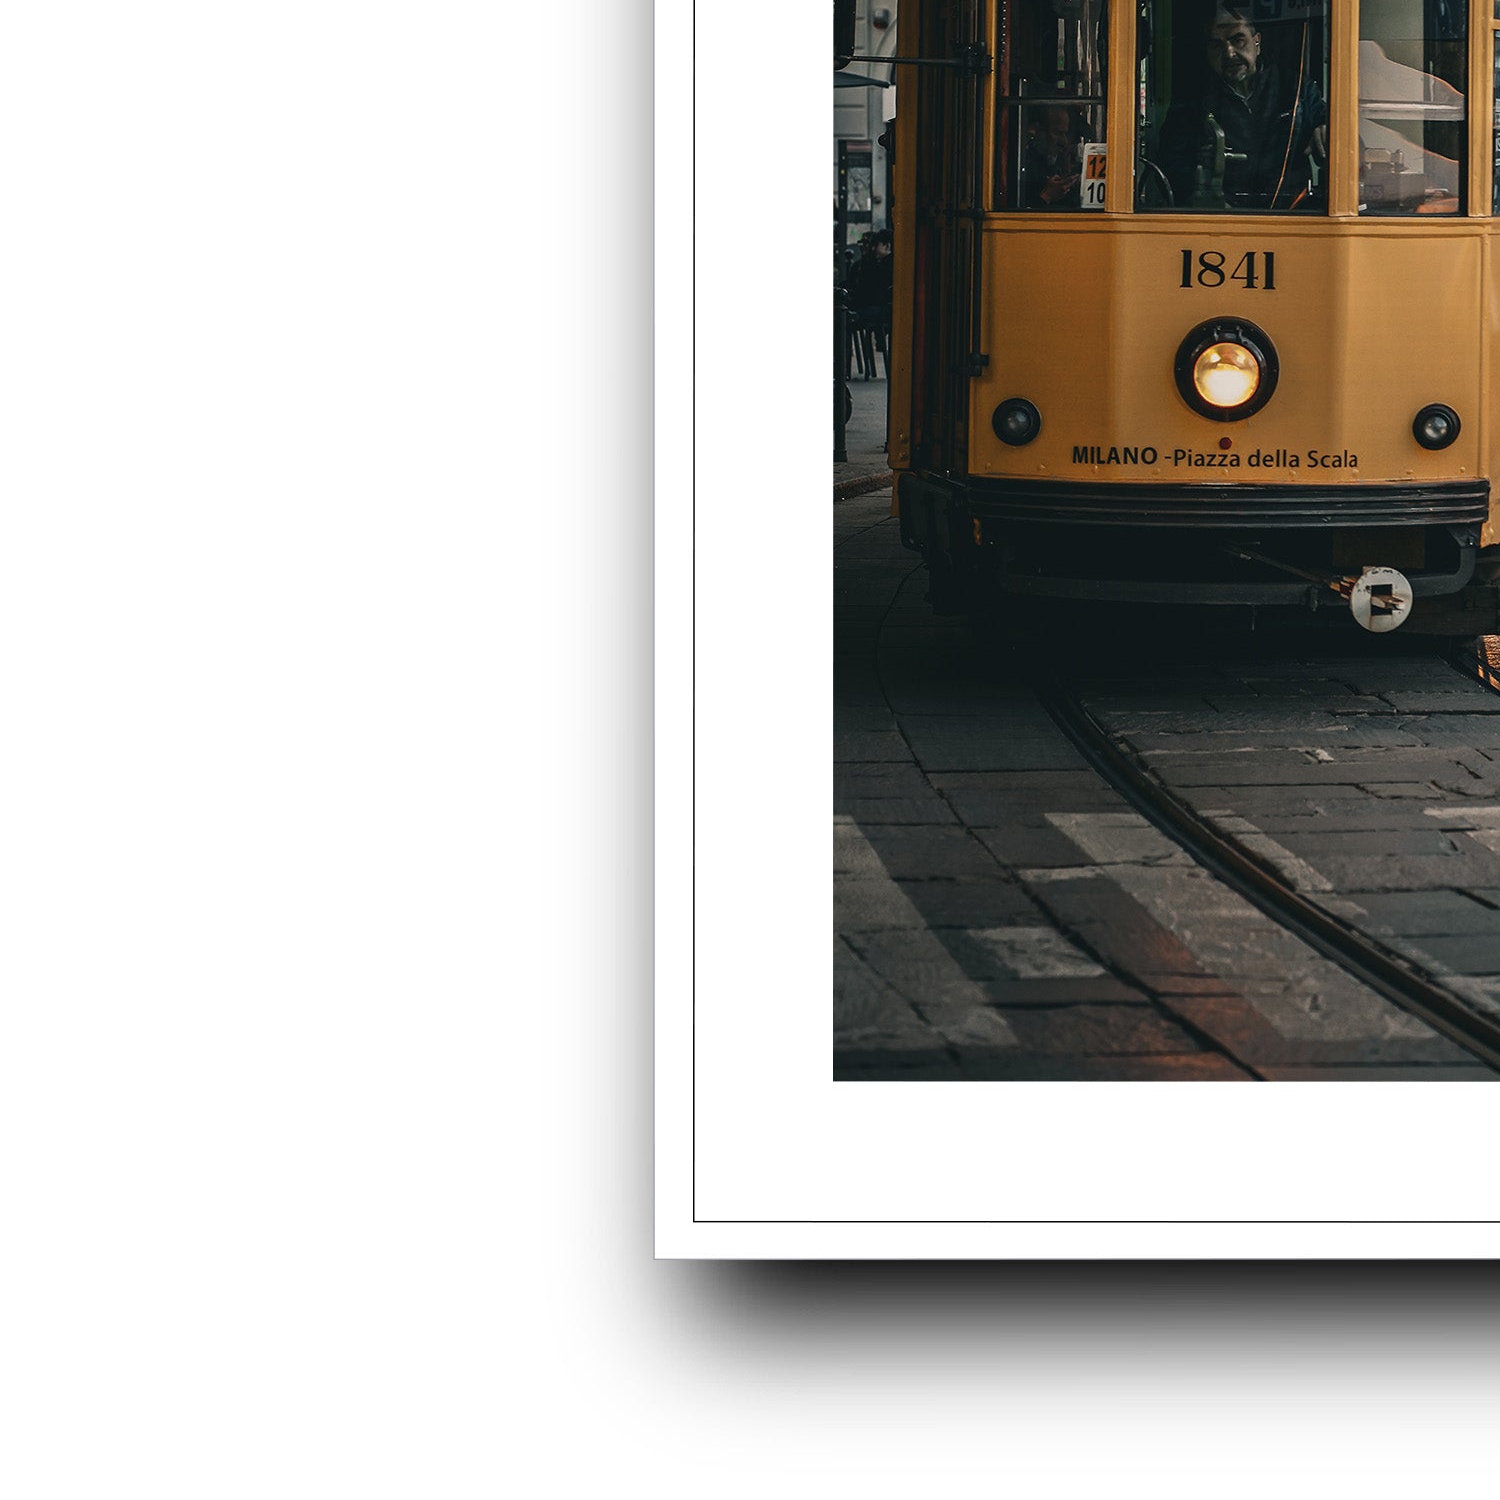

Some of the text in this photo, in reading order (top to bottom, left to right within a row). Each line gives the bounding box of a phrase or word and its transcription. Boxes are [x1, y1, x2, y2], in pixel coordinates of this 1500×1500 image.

[1089, 156, 1106, 178] 12
[1087, 182, 1106, 204] 10
[1179, 249, 1277, 290] 1841
[1072, 446, 1158, 465] MILANO
[1247, 450, 1300, 468] della
[1307, 450, 1358, 469] Scala
